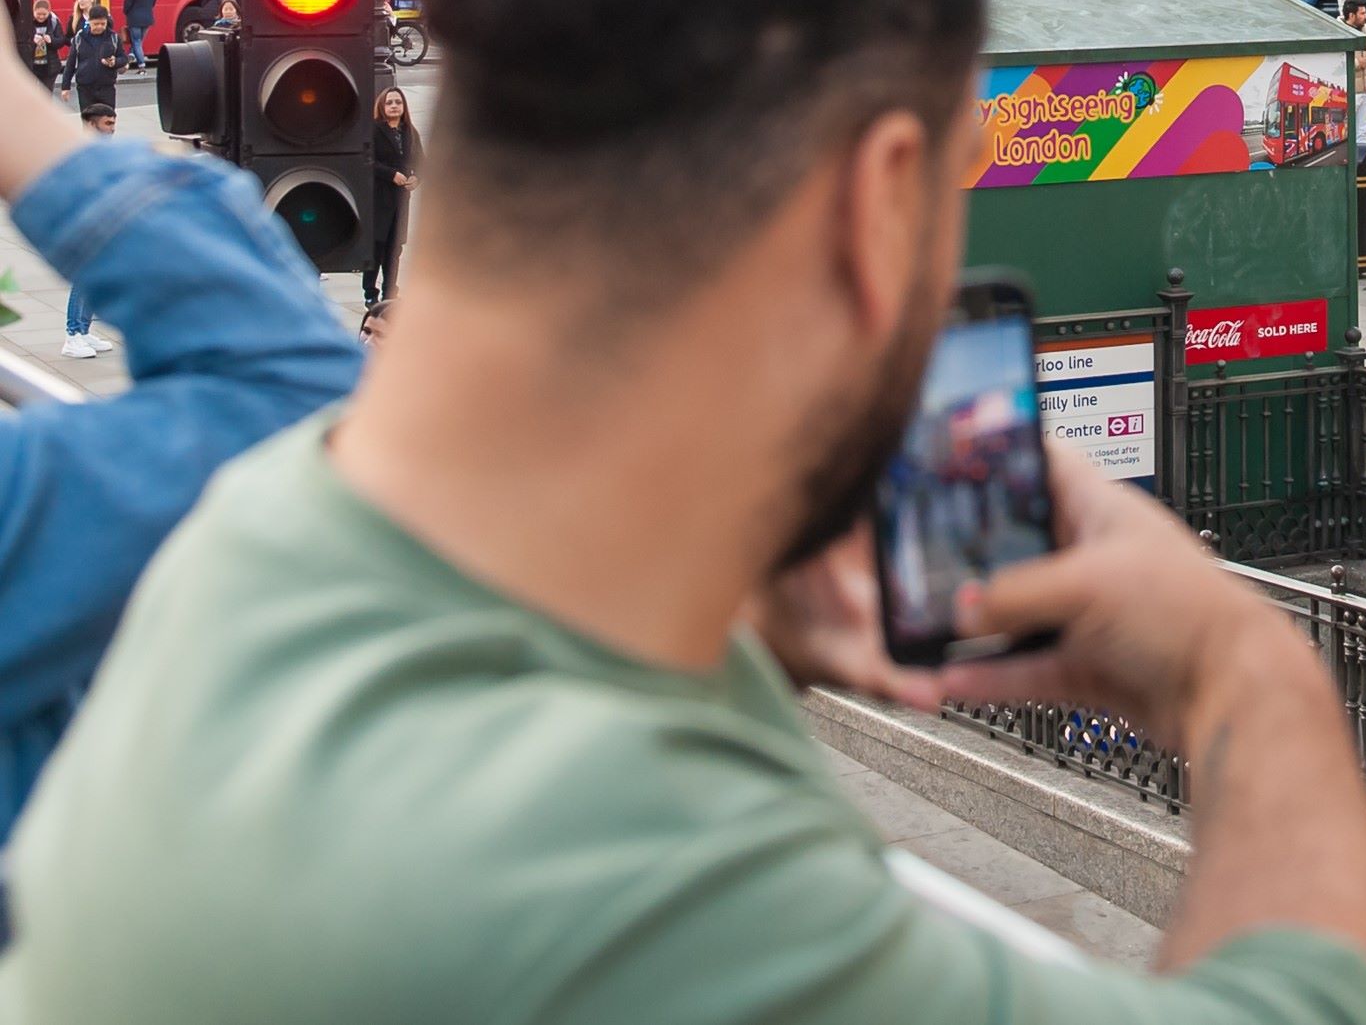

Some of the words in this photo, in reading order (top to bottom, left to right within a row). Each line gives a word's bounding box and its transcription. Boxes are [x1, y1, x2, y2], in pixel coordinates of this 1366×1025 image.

[996, 91, 1134, 128] Sightseeing
[995, 129, 1090, 165] London
[1257, 326, 1287, 338] SOLD
[1289, 322, 1318, 335] HERE
[1068, 355, 1094, 370] line
[1039, 396, 1069, 413] dilly
[1073, 394, 1098, 408] line
[1055, 424, 1103, 440] Centre
[1094, 446, 1120, 458] closed
[1121, 445, 1141, 455] after
[1103, 455, 1141, 467] Thursdays
